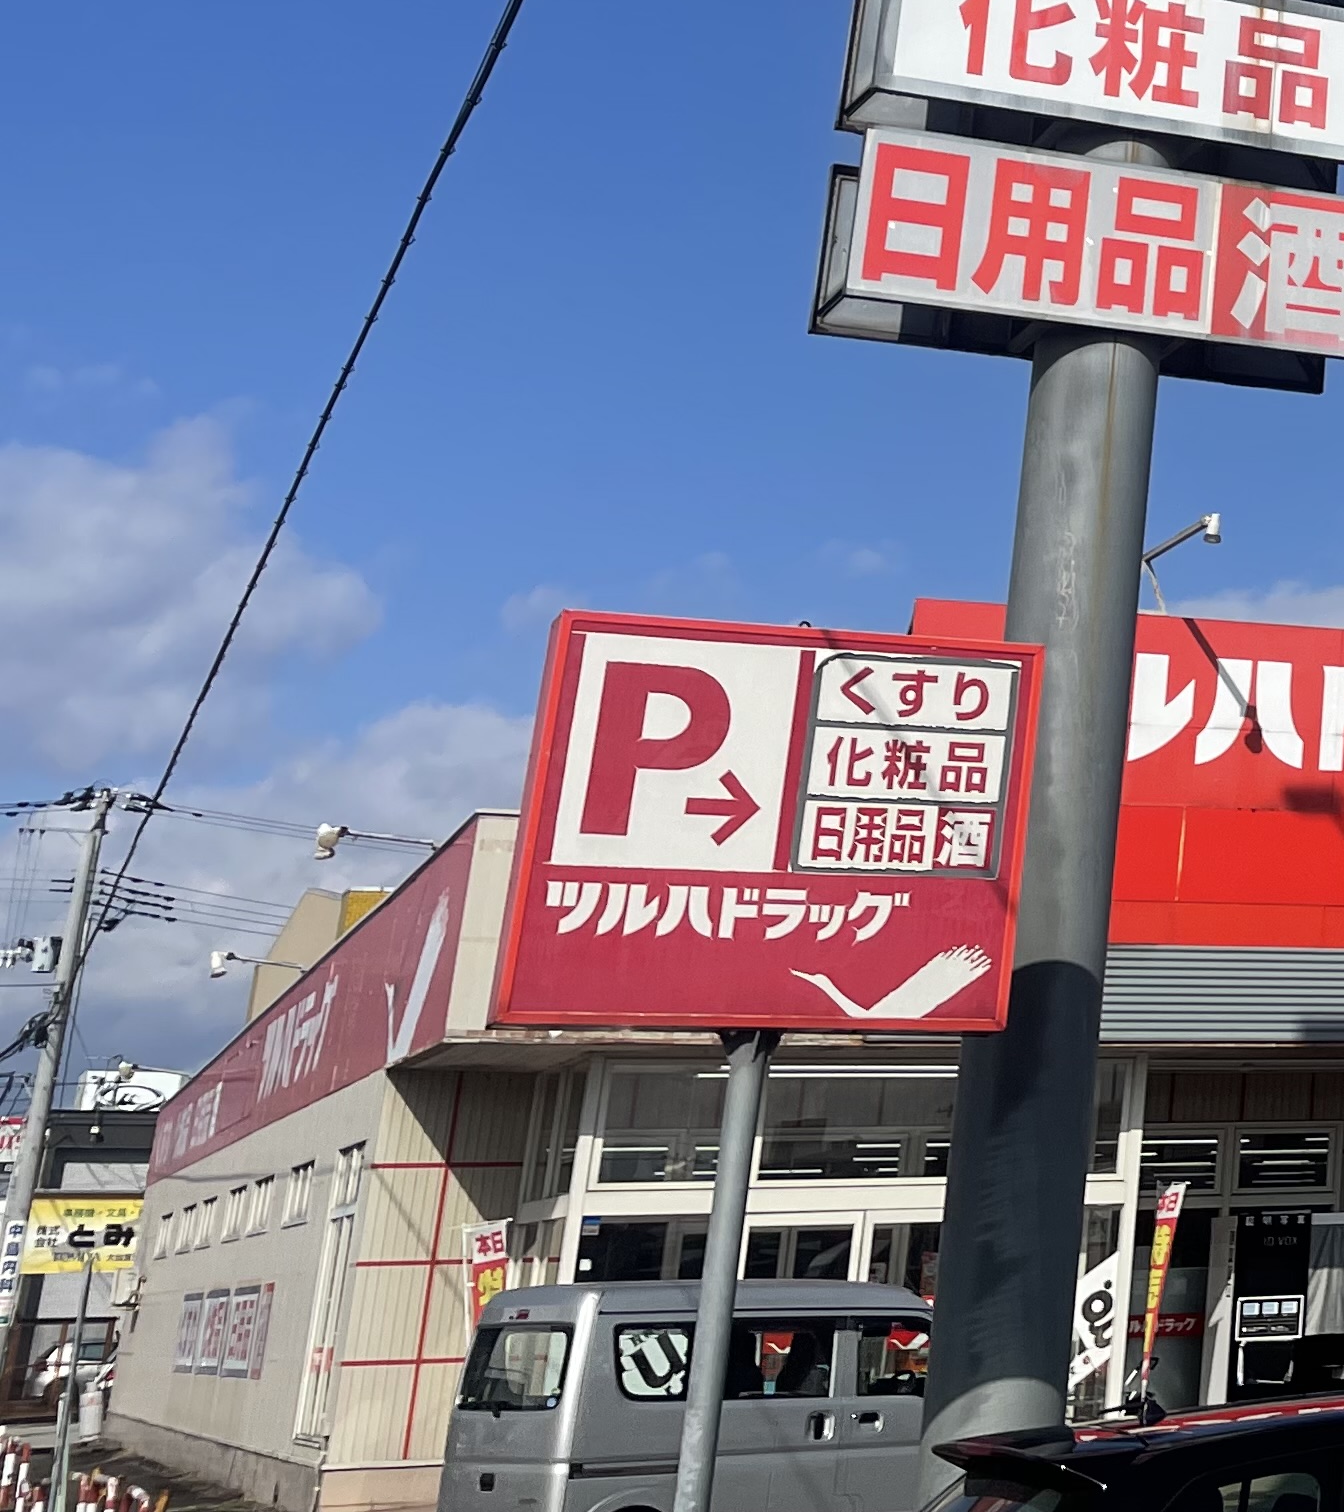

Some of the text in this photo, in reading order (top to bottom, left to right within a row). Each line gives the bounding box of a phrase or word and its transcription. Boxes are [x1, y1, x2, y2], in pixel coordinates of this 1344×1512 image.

[860, 141, 1202, 321] 日用品
[839, 665, 990, 721] くすり
[579, 660, 731, 836] P
[825, 735, 987, 794] 化粧品
[809, 806, 994, 868] 日用品 酒
[545, 879, 911, 945] ツルハドラッグ
[67, 1223, 135, 1248] とみ
[475, 1231, 504, 1256] 本日
